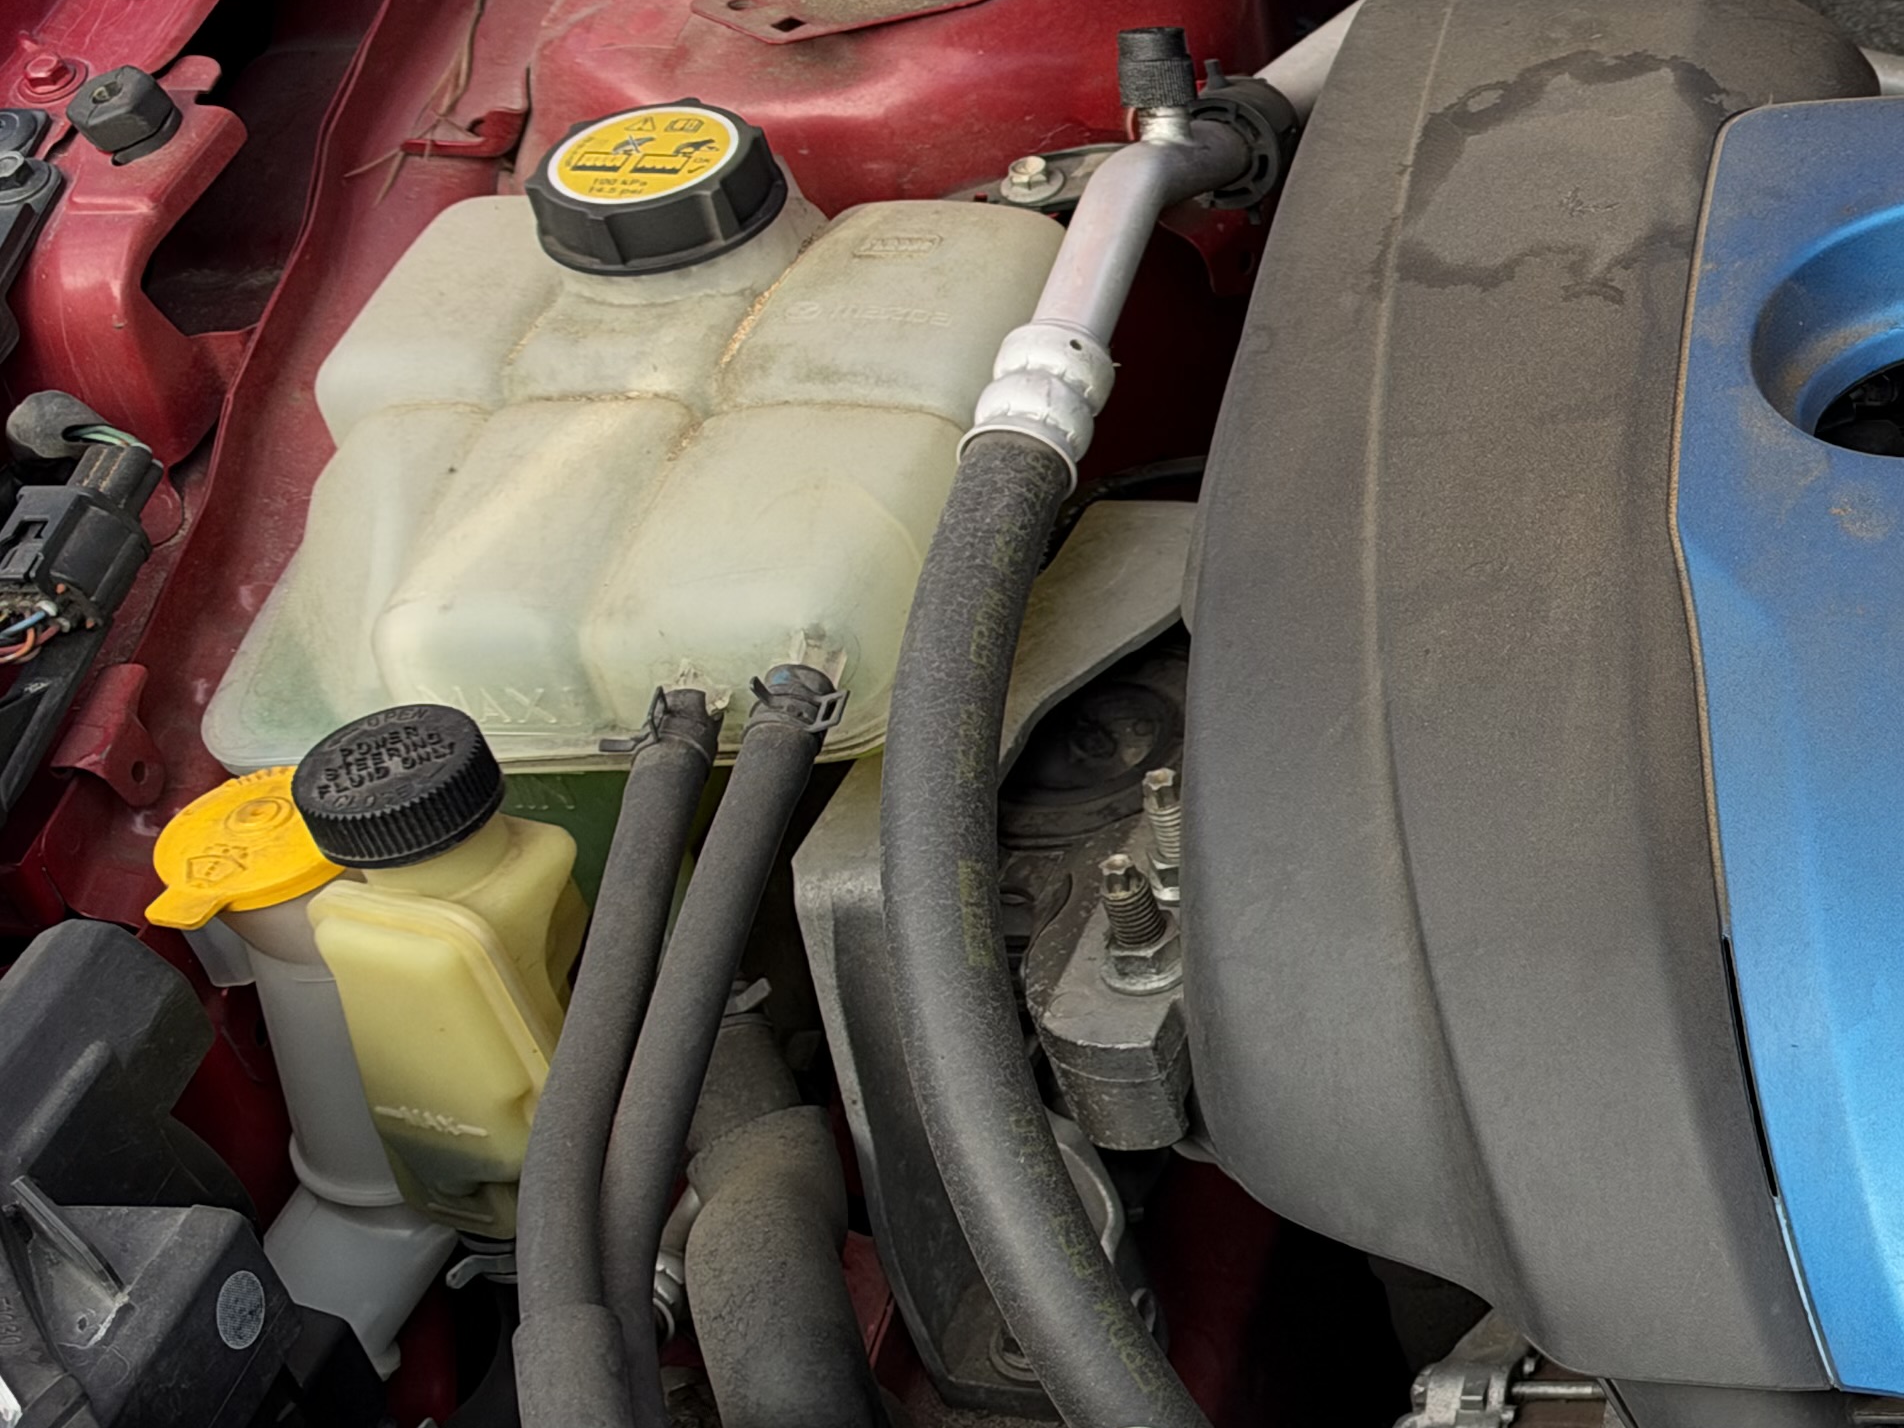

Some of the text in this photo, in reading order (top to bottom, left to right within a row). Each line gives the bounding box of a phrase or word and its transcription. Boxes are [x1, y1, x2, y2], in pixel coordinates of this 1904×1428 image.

[366, 707, 429, 728] OPEN
[323, 731, 444, 782] STEERING
[339, 725, 420, 757] POWER
[317, 741, 457, 800] FLUID ONLY
